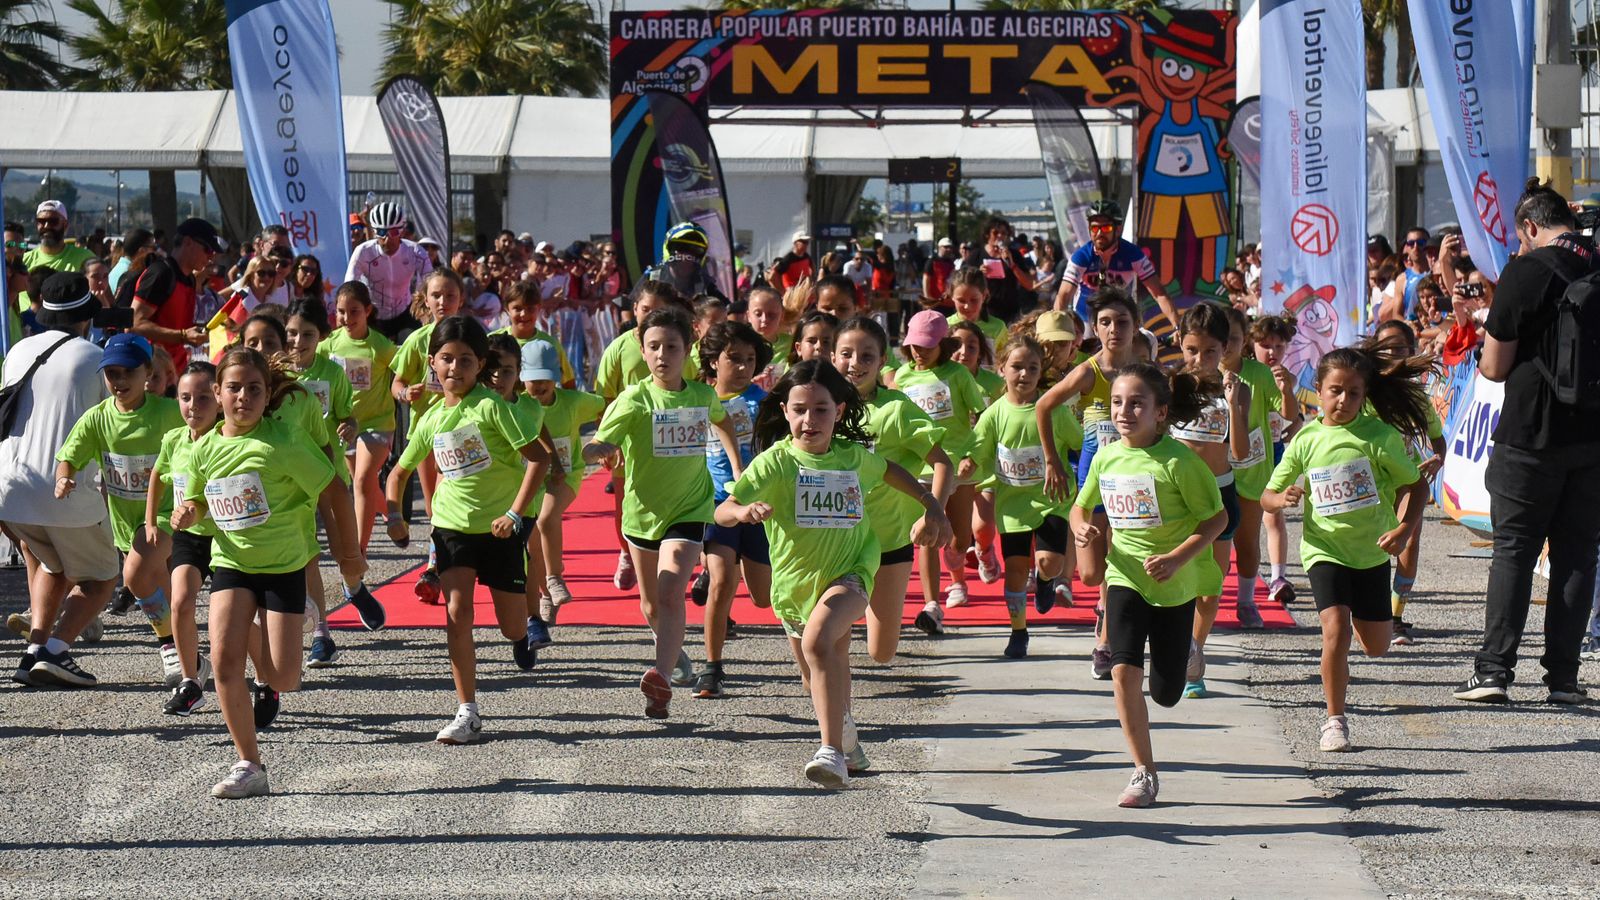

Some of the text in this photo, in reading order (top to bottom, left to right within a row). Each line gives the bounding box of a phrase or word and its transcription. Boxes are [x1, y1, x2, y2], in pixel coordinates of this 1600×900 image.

[620, 13, 1112, 40] CARRERA POPULAR PUERTO BAHÍA DE ALGECIRAS
[636, 70, 686, 79] Puerto de
[732, 44, 1114, 94] META
[657, 425, 697, 444] 1132
[436, 448, 466, 468] 1059
[107, 467, 140, 488] 1019
[799, 475, 812, 484] XXI
[801, 490, 844, 512] 1440
[1315, 480, 1354, 503] 1453
[211, 495, 244, 516] 1060
